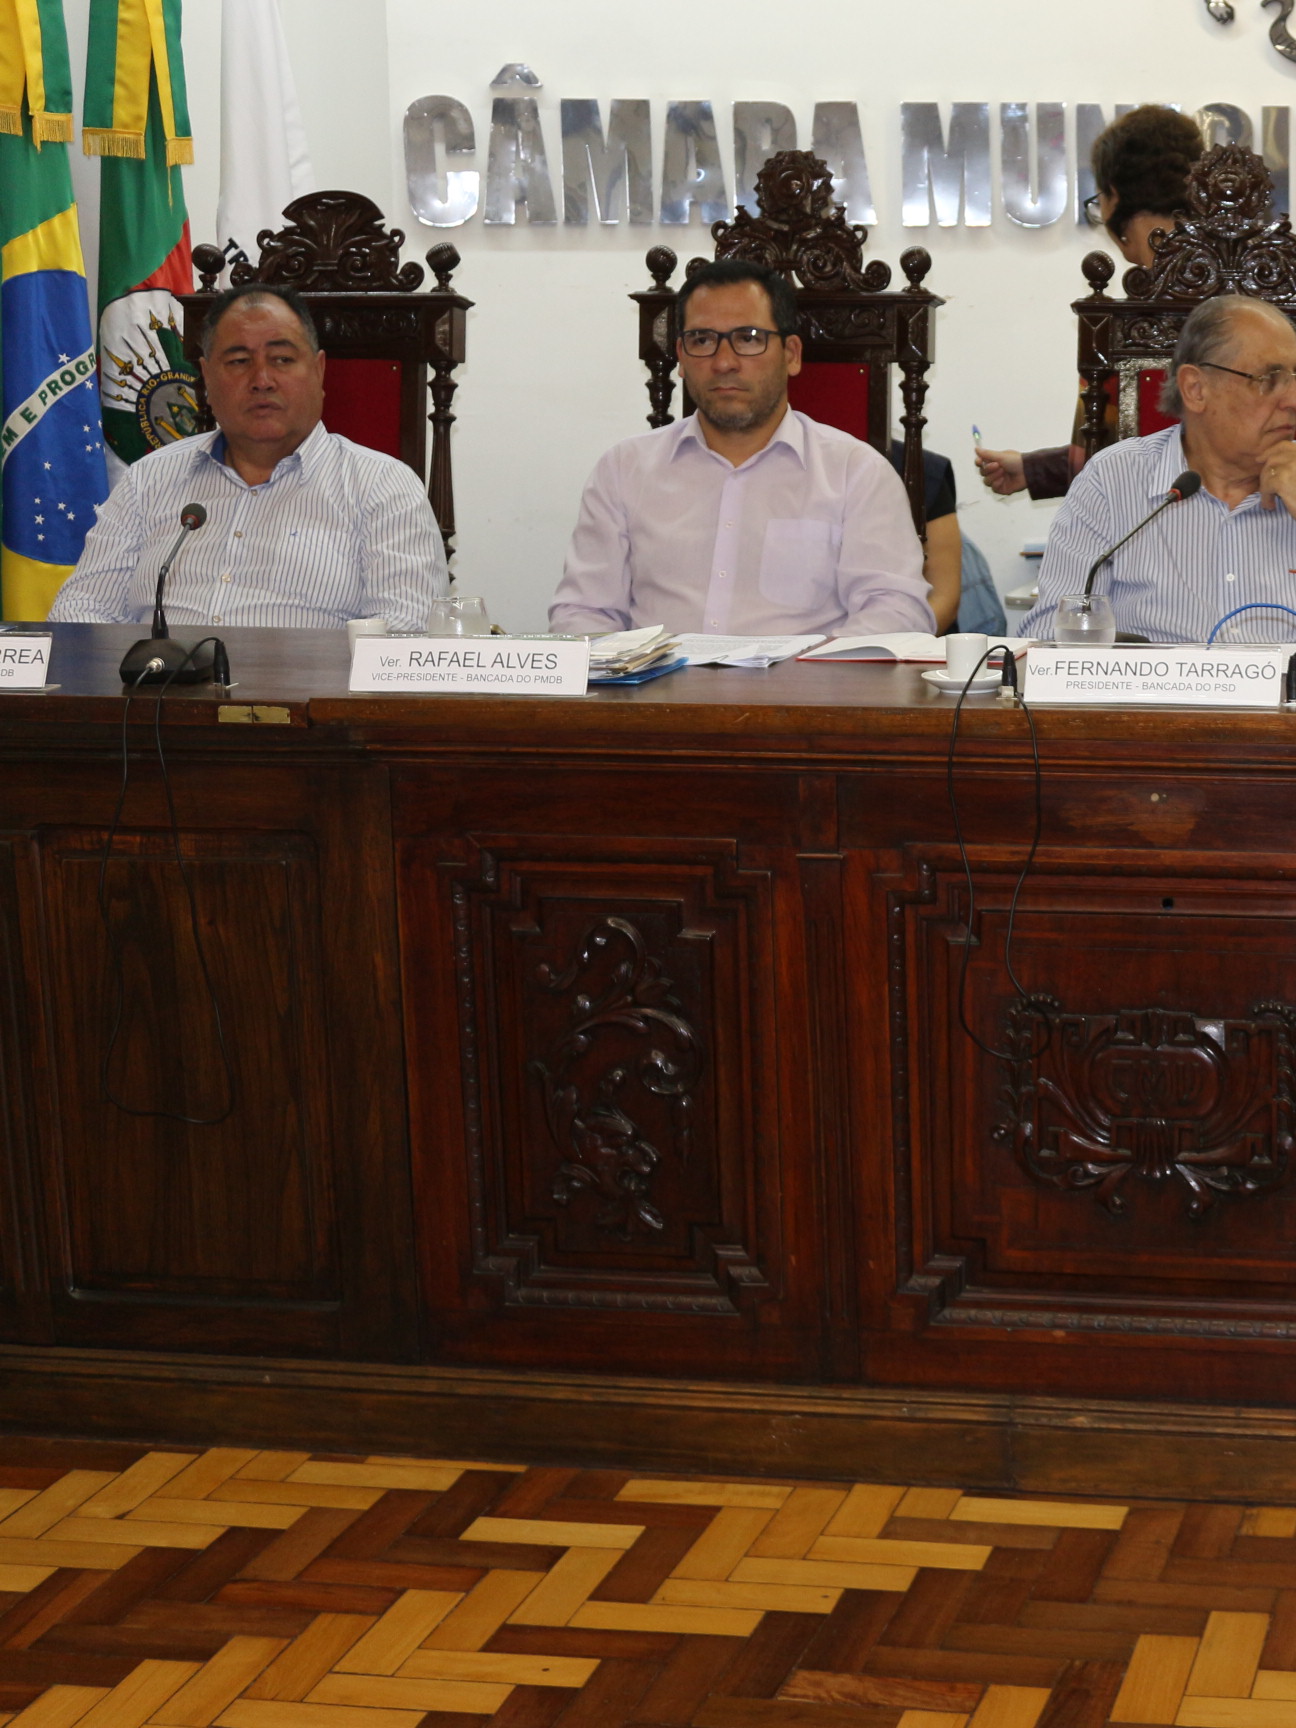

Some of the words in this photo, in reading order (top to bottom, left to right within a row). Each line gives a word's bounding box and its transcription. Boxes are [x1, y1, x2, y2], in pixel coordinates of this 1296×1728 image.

[403, 62, 878, 228] CÂMARA
[20, 407, 38, 424] E
[0, 648, 45, 664] REA
[379, 655, 402, 668] Ver.
[408, 650, 487, 668] RAFAEL
[490, 652, 558, 670] ALVES
[371, 672, 458, 681] VICE-PRESIDENTE
[466, 673, 514, 683] BANCADA
[516, 675, 532, 683] DO
[533, 675, 563, 684] PMDB
[1054, 660, 1169, 677] FERNANDO
[1175, 661, 1276, 680] TARRAGÓ
[1065, 680, 1132, 690] PRESIDENTE
[1141, 681, 1193, 692] BANCADA
[1195, 682, 1211, 692] DO
[1214, 683, 1237, 692] PSD
